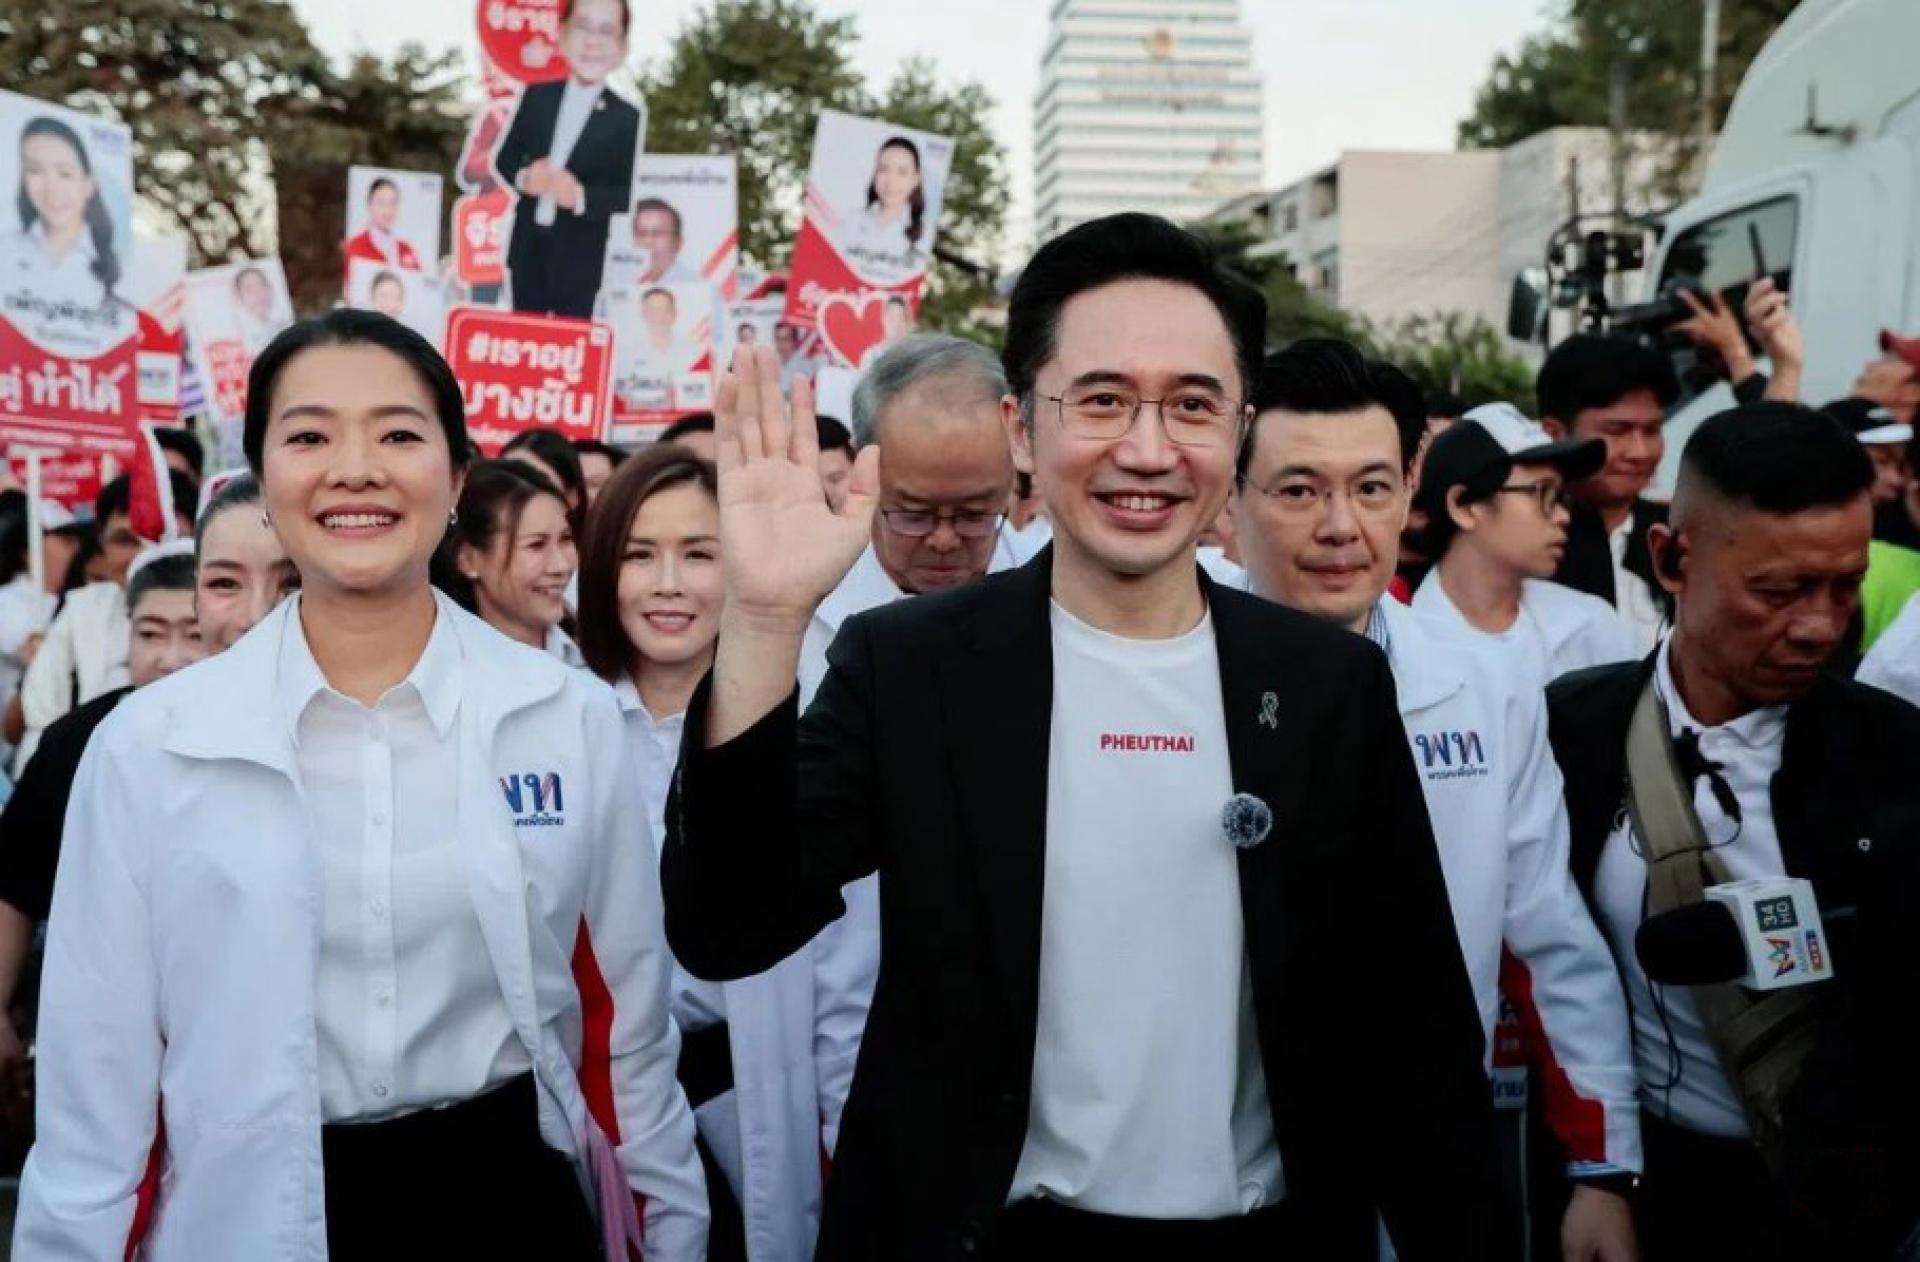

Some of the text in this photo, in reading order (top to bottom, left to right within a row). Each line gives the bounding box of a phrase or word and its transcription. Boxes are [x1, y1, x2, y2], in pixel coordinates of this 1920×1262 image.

[468, 331, 587, 384] #เราอยู่
[27, 361, 131, 416] ทำได้
[457, 377, 594, 426] บางชัน
[1100, 733, 1195, 752] PHEUTHAI
